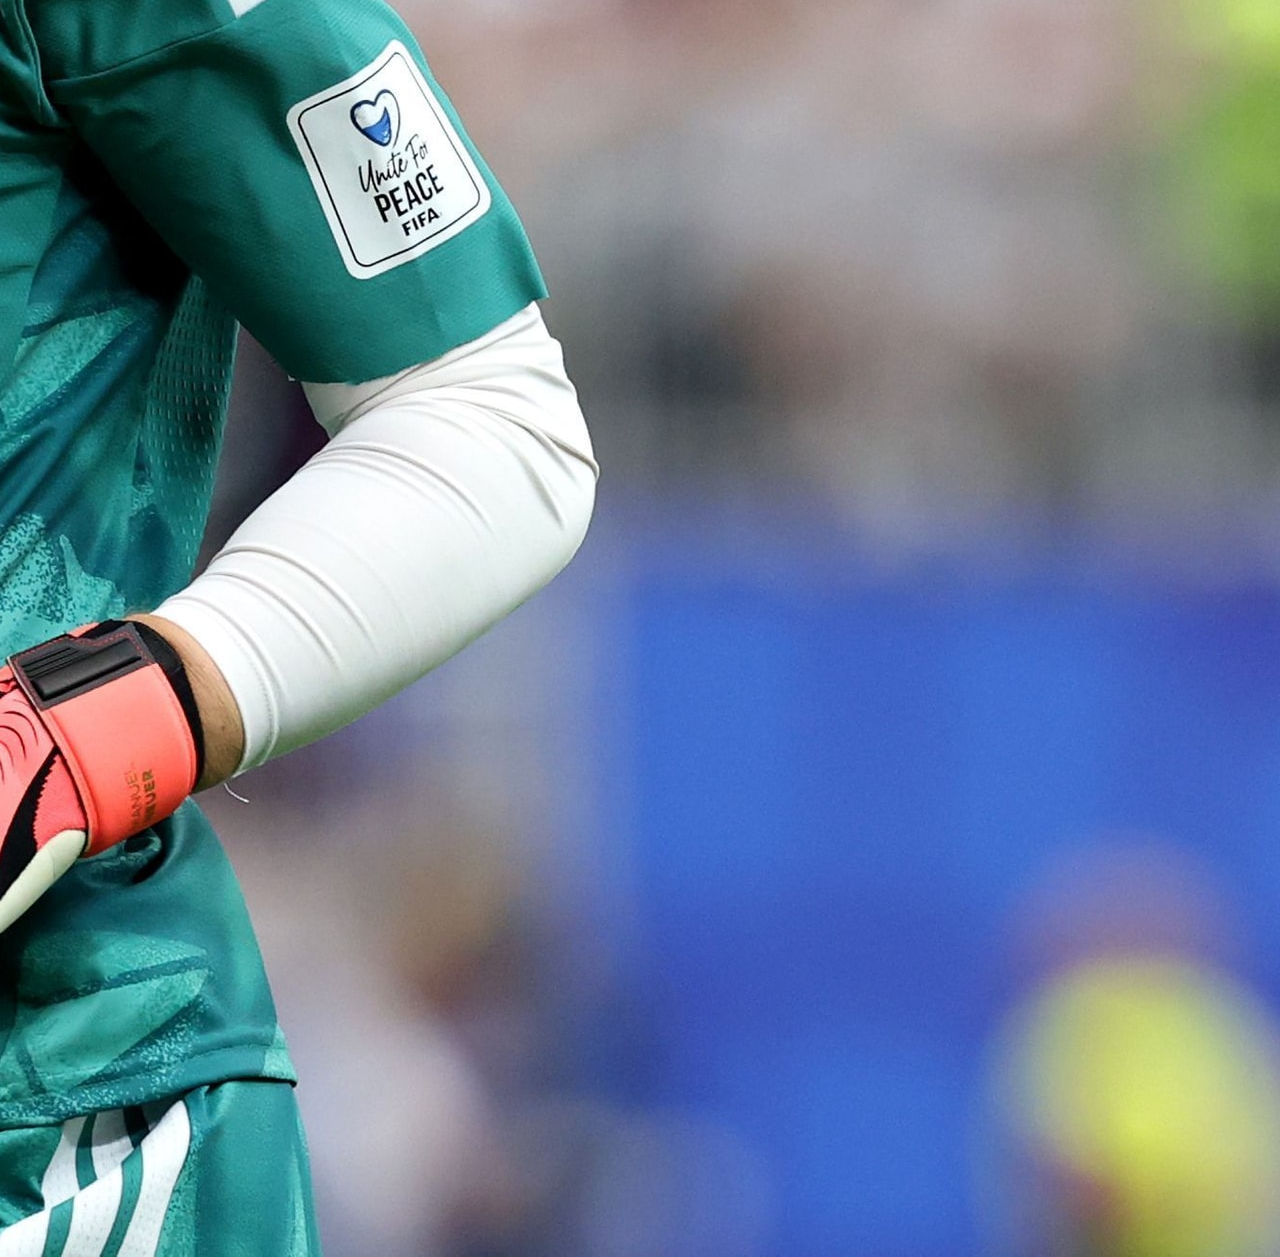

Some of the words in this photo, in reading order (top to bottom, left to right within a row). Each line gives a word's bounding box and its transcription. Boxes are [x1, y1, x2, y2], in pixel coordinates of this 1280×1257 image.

[358, 151, 409, 193] Unite
[405, 134, 429, 169] For
[374, 164, 444, 223] PEACE
[401, 207, 441, 237] FIFA
[142, 769, 157, 821] UER
